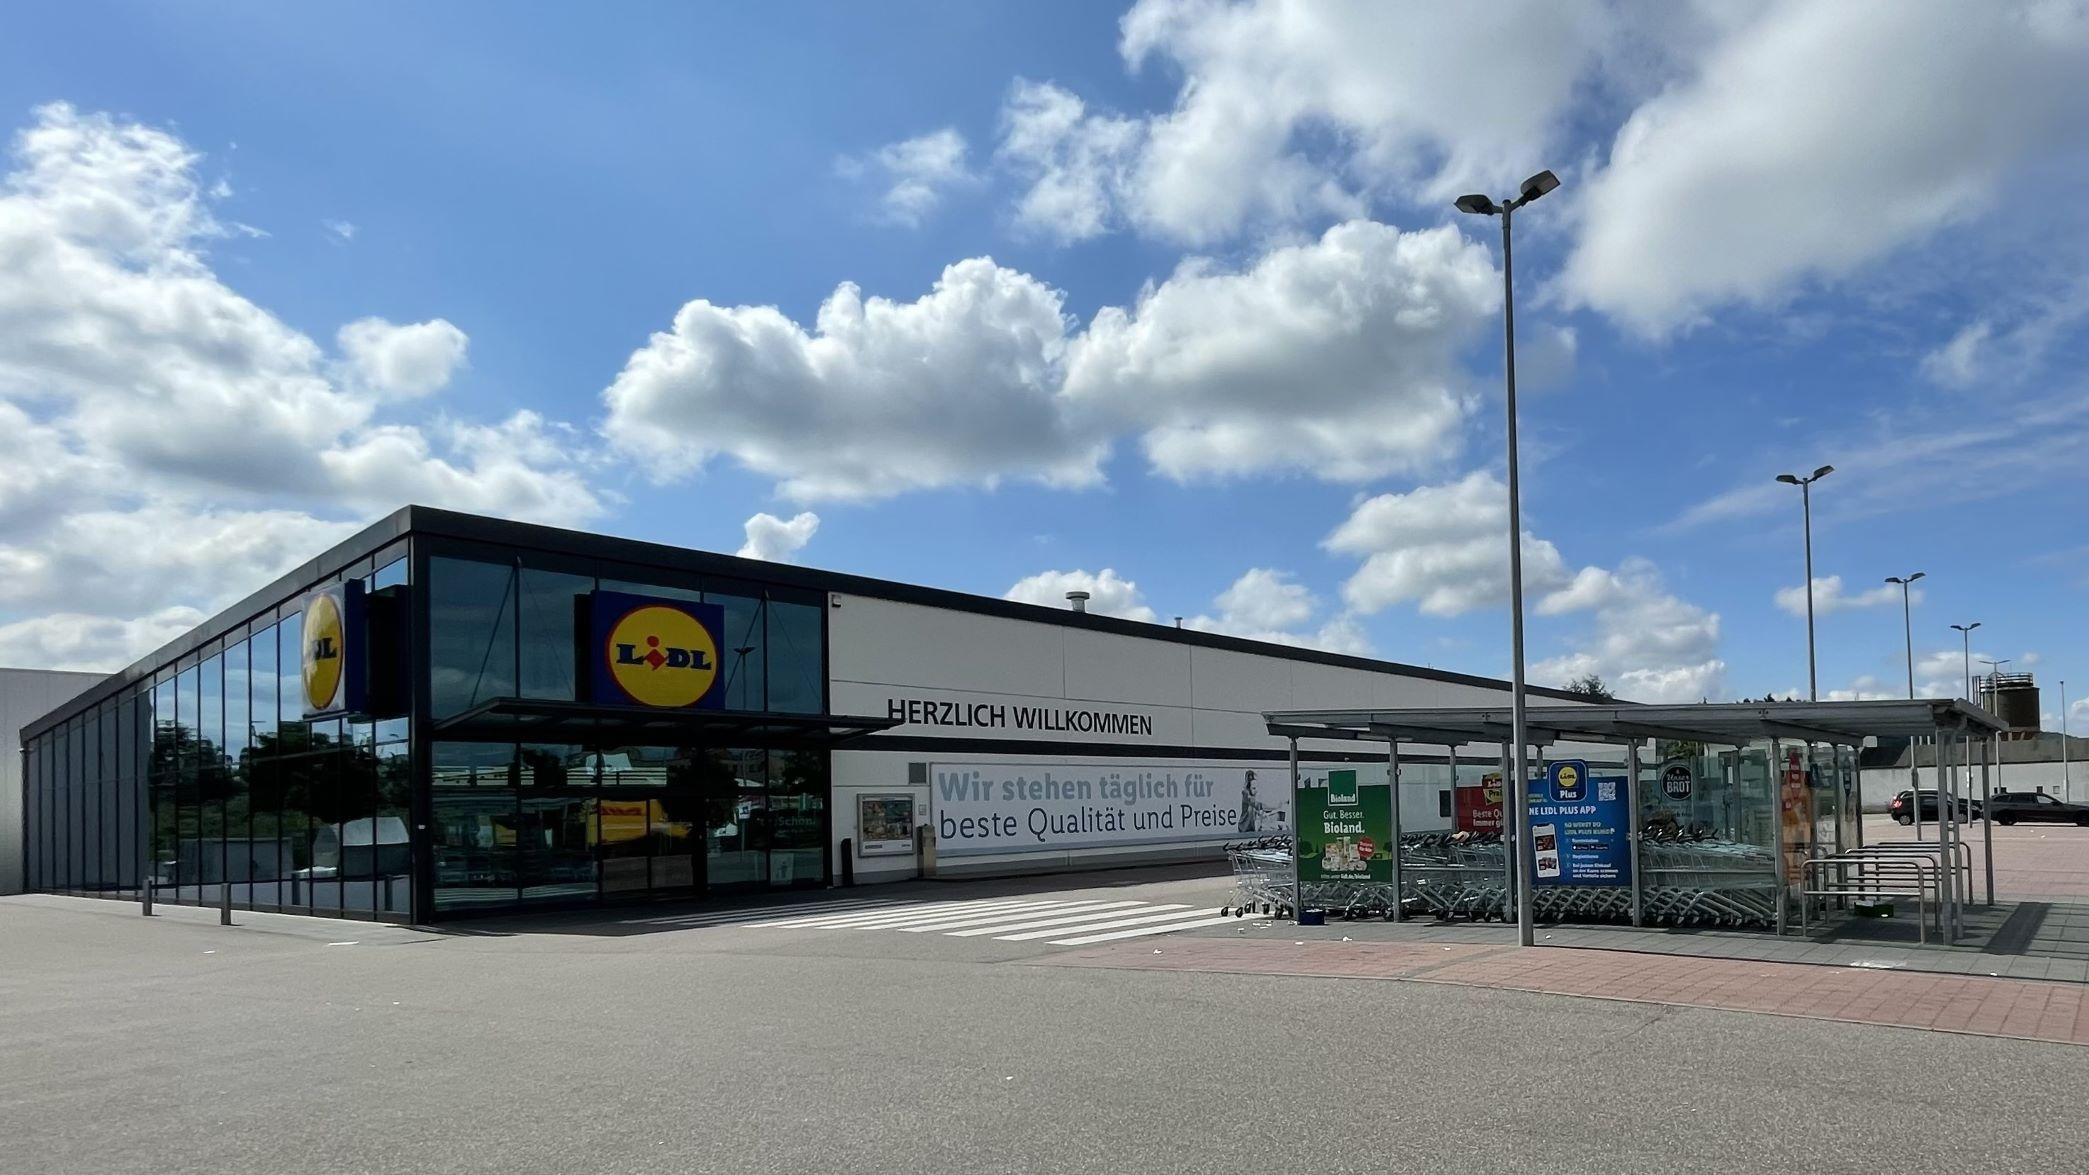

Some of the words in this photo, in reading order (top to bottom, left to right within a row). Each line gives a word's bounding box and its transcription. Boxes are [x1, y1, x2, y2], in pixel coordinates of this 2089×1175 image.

[887, 698, 1006, 728] HERZLICH
[1013, 706, 1153, 736] WILLKOMMEN
[938, 771, 994, 801] Wir
[1002, 773, 1092, 801] stehen
[1100, 772, 1178, 806] täglich
[1184, 773, 1214, 798] für
[1666, 780, 1691, 793] BROT
[1330, 793, 1356, 803] Bioland
[1559, 789, 1577, 799] Plus
[1323, 810, 1337, 820] Gut.
[1339, 809, 1365, 819] Besser.
[1472, 809, 1493, 818] Beste
[1540, 806, 1558, 816] LIDL
[1559, 805, 1579, 815] PLUS
[1579, 805, 1597, 815] APP
[940, 810, 1017, 839] beste
[1028, 805, 1126, 842] Qualität
[1133, 804, 1173, 831] und
[1180, 803, 1238, 828] Preise
[1323, 820, 1366, 834] Bioland.
